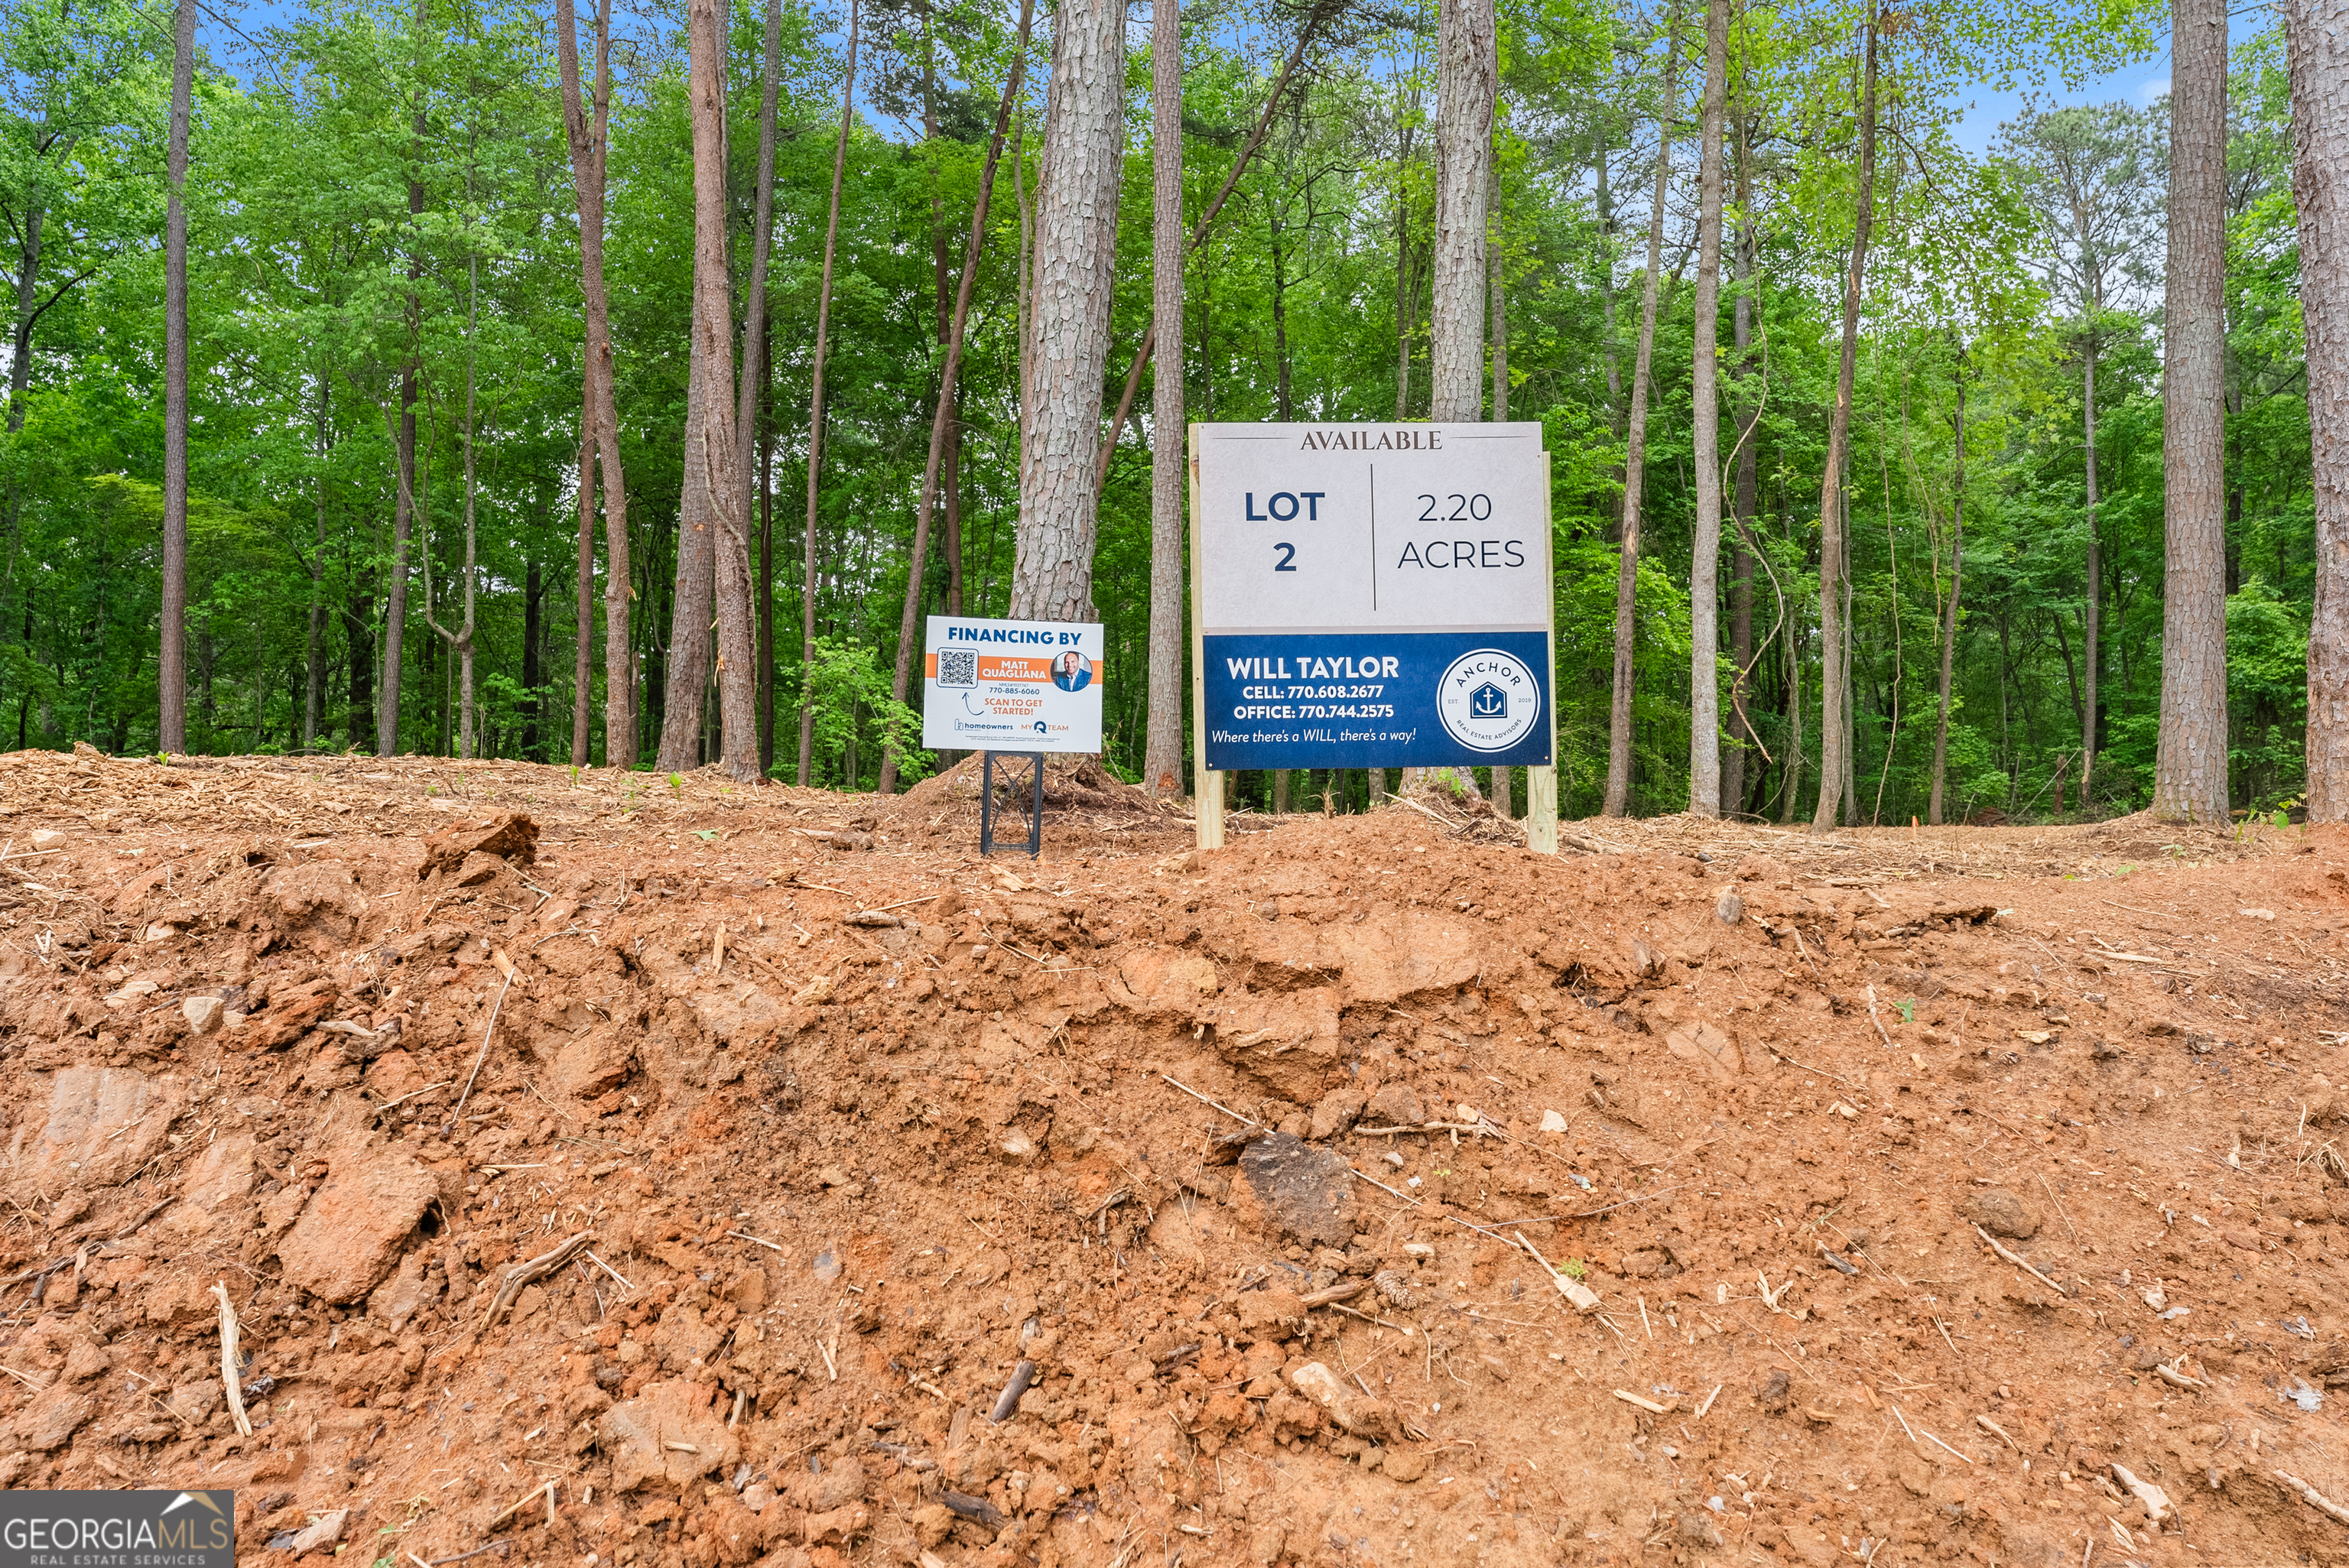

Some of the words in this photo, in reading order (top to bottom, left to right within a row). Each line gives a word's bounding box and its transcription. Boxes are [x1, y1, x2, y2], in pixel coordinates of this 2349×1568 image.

[1300, 430, 1443, 450] AVAILABLE
[1245, 492, 1325, 521] LOT
[1417, 493, 1492, 521] 2.20
[1273, 542, 1297, 572] 2
[1397, 540, 1525, 569] ACRES
[948, 627, 1054, 644] FINANCING
[1059, 632, 1082, 645] BY
[982, 668, 1047, 679] QUAGLIANA
[1001, 661, 1028, 670] MATT
[1226, 657, 1291, 680] WILL
[1296, 656, 1399, 679] TAYLOR
[1456, 662, 1521, 687] ANCHOR
[1243, 686, 1285, 700] CELL:
[1287, 685, 1384, 700] 770.608.2677
[993, 707, 1034, 716] STARTED!
[1233, 706, 1295, 719] OFFICE:
[1298, 704, 1394, 719] 770.744.2575
[1212, 730, 1249, 743] Where
[1252, 729, 1289, 742] there's
[1292, 734, 1299, 742] a
[1303, 729, 1337, 745] WILL,
[1340, 729, 1376, 742] there's
[1379, 732, 1386, 741] a
[1389, 728, 1416, 743] way!
[1456, 719, 1469, 733] REAL
[1470, 731, 1493, 740] ESTATE
[1494, 718, 1522, 739] ADVISORS
